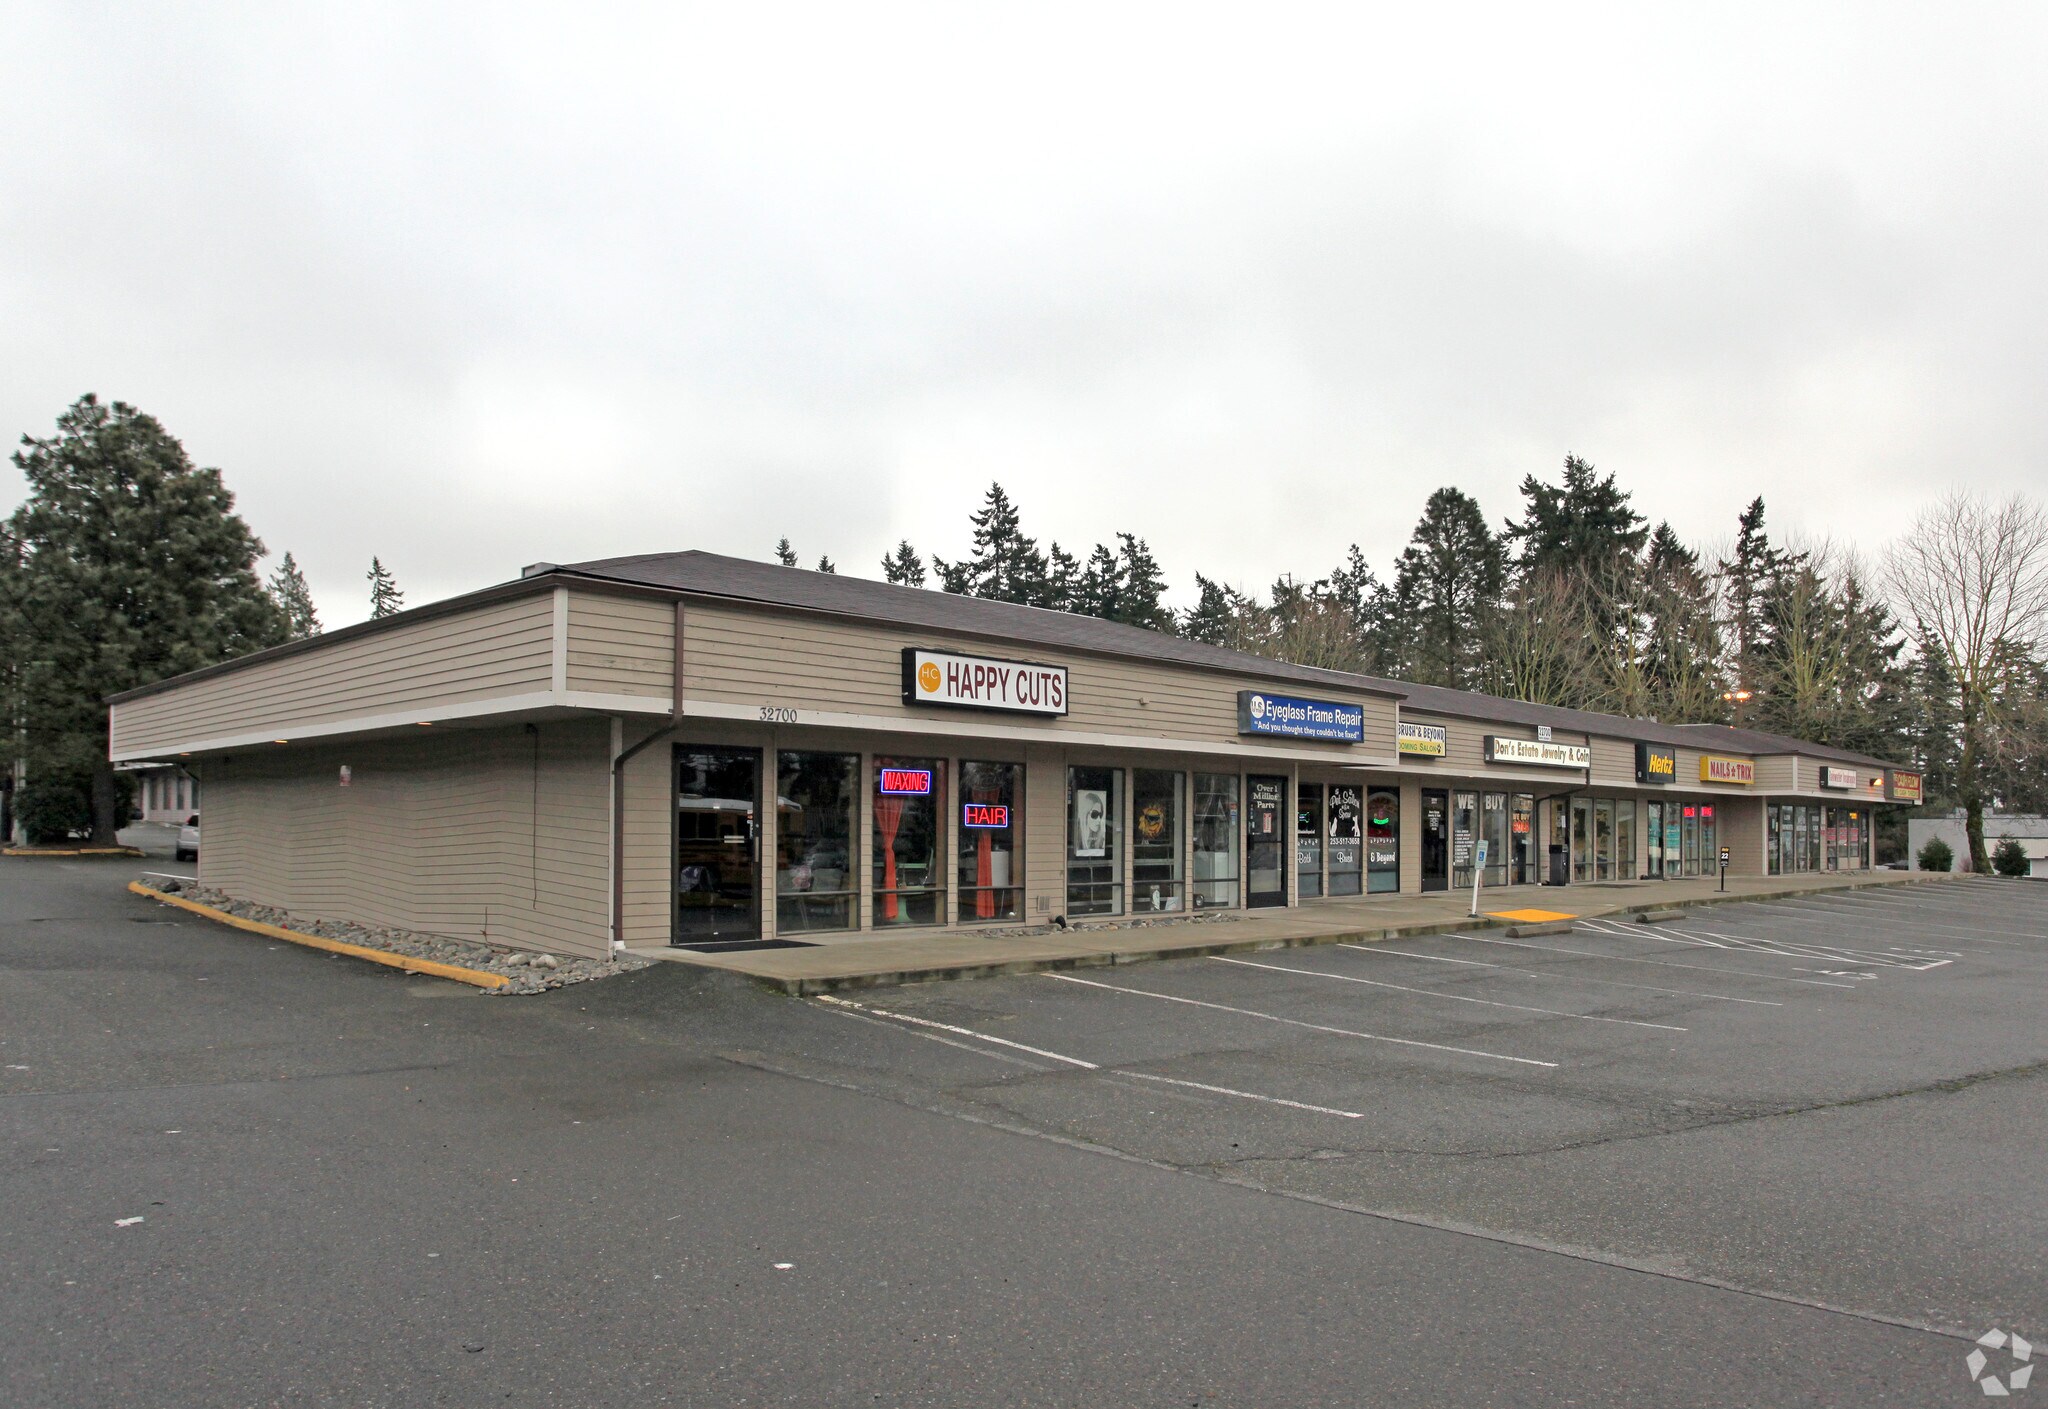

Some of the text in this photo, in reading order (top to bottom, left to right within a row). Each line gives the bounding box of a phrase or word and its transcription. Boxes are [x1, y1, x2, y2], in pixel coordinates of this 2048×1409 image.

[922, 666, 938, 680] HC
[947, 662, 1062, 708] HAPPY CUTS
[760, 707, 798, 723] 32700
[1266, 701, 1361, 728] Eyeglass Frame Repair
[1270, 724, 1281, 732] you
[1281, 724, 1303, 735] thought
[1304, 726, 1315, 736] they
[1316, 728, 1337, 737] couldn't
[1337, 730, 1344, 738] be
[1418, 726, 1422, 737] &
[1494, 739, 1589, 763] Don's Estate Jewelry & Coin
[1648, 754, 1674, 774] Hertz
[1710, 761, 1752, 780] NAILS TRIX
[884, 771, 928, 791] WAXING
[1256, 784, 1273, 792] Over
[1329, 791, 1360, 808] Pet Salon
[1457, 794, 1474, 809] WE
[1485, 795, 1504, 809] BUY
[966, 807, 1006, 825] HAIR
[1376, 852, 1396, 864] Beyond
